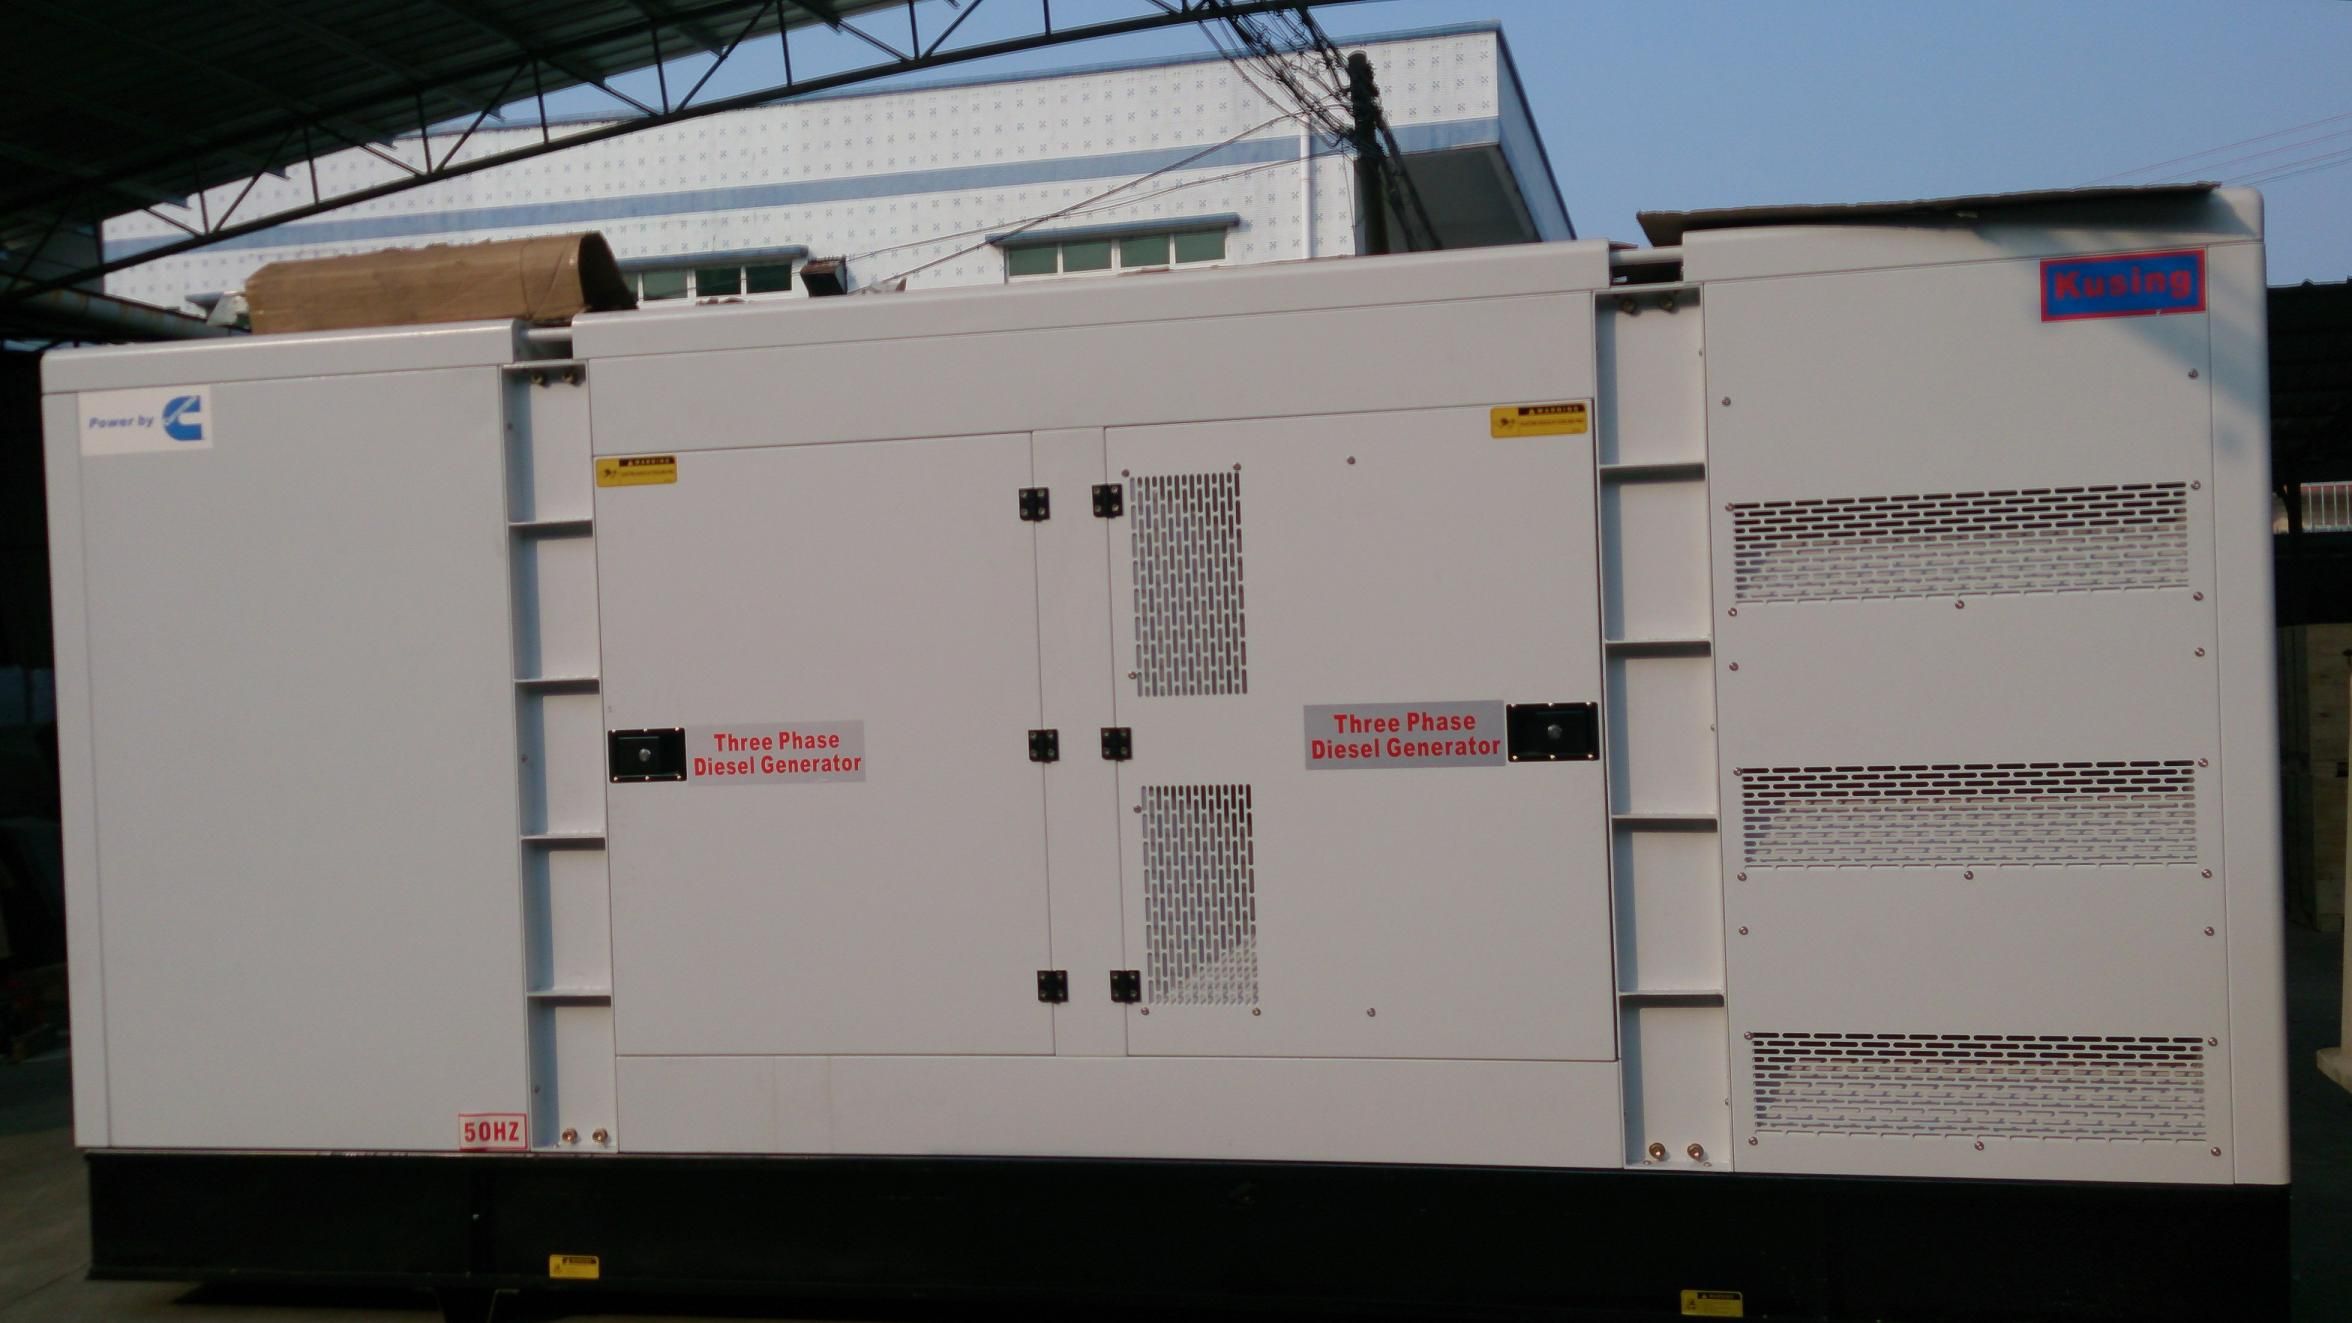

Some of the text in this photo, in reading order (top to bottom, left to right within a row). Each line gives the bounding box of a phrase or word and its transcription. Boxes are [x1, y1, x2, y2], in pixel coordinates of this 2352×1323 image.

[2055, 266, 2192, 300] Kusing
[88, 415, 154, 429] Power by
[1333, 711, 1477, 734] Three Phase
[713, 731, 840, 752] Three Phase
[1311, 736, 1501, 760] Diesel Generator
[694, 754, 862, 776] Diesel Generator
[464, 1120, 519, 1142] 50HZ
